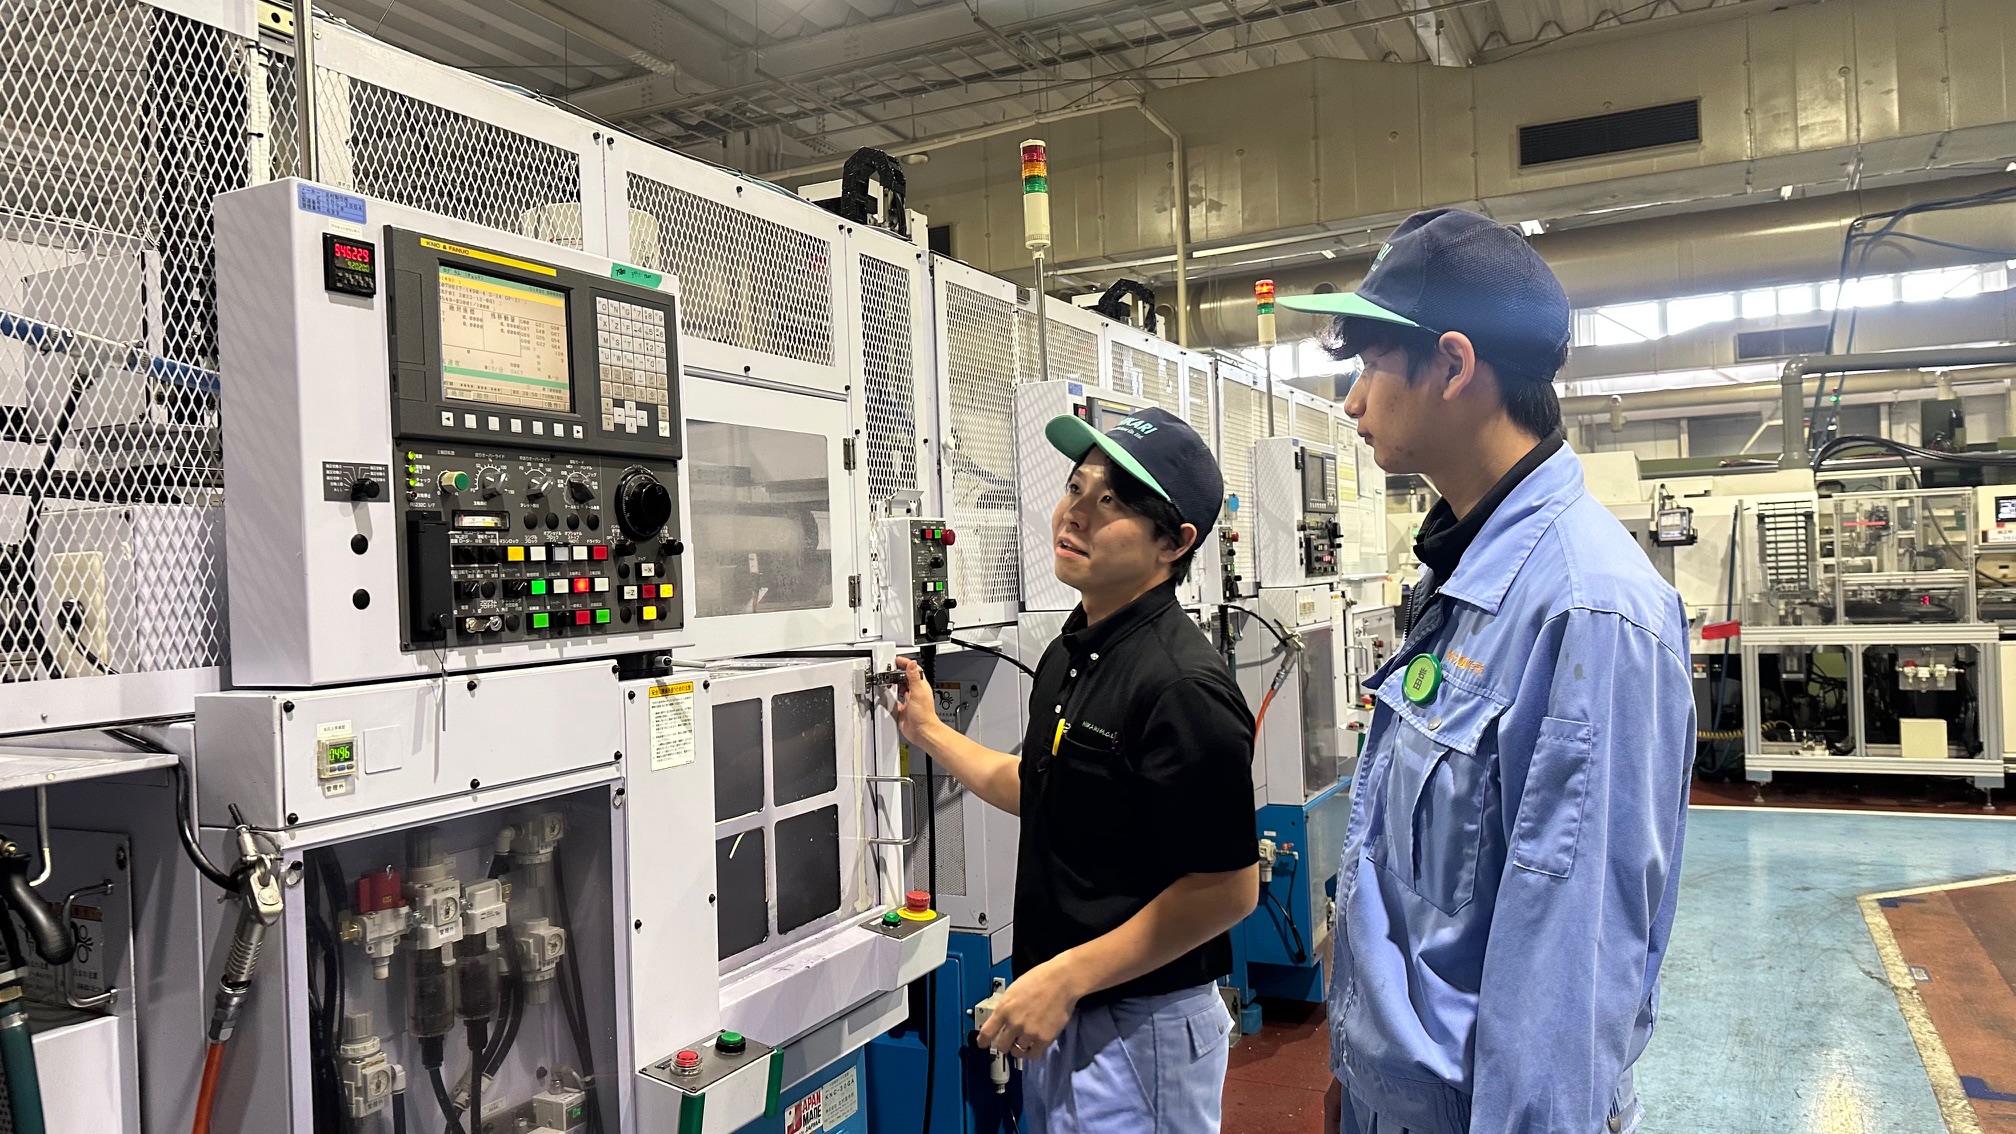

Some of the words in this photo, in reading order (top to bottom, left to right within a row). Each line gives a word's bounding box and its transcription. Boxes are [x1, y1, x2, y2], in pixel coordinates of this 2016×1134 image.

[334, 243, 369, 263] 945229
[448, 245, 470, 255] FANUC
[802, 1104, 821, 1127] MADE
